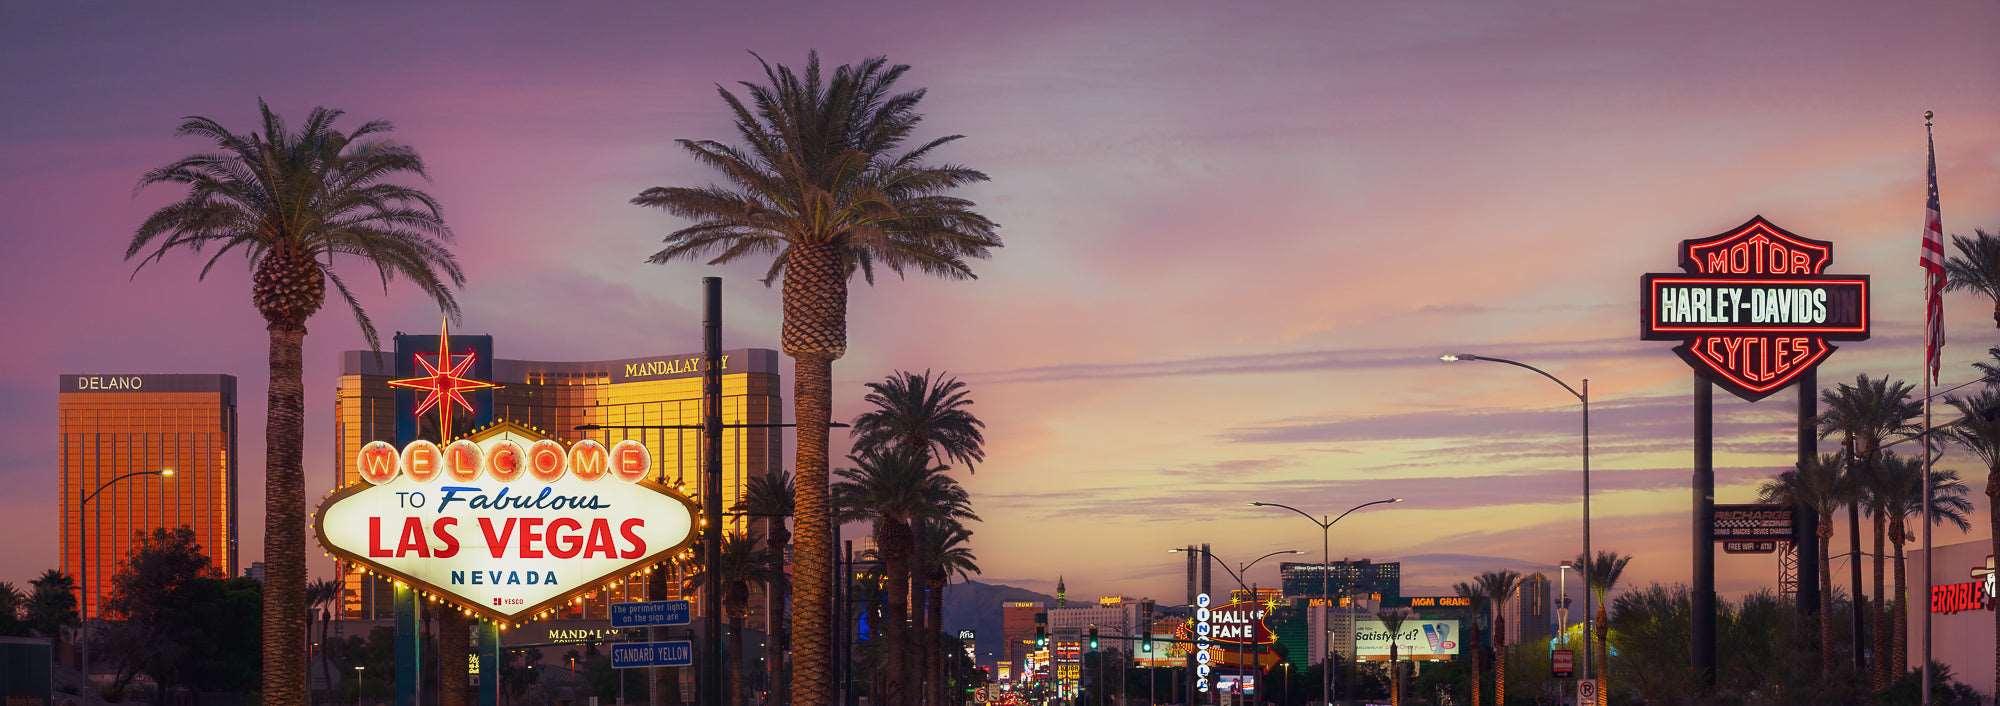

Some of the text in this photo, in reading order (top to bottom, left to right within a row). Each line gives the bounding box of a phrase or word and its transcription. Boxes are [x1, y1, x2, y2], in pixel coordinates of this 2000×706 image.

[1708, 233, 1811, 275] MOTOR
[624, 357, 700, 378] MANDALAY
[1707, 337, 1809, 382] CYCLES
[78, 376, 143, 390] DELANO
[363, 446, 642, 477] WELCOME
[396, 486, 611, 513] TO Fabulous
[368, 516, 648, 560] LAS VEGAS
[450, 570, 559, 585] NEVADA
[1411, 597, 1435, 607] MGM
[1930, 581, 1982, 615] ERRIBLE
[629, 604, 664, 614] perimeter
[667, 602, 687, 612] lights
[1212, 611, 1249, 623] HALL
[1212, 625, 1253, 638] FAME
[614, 646, 689, 662] STANDARD YELLOW
